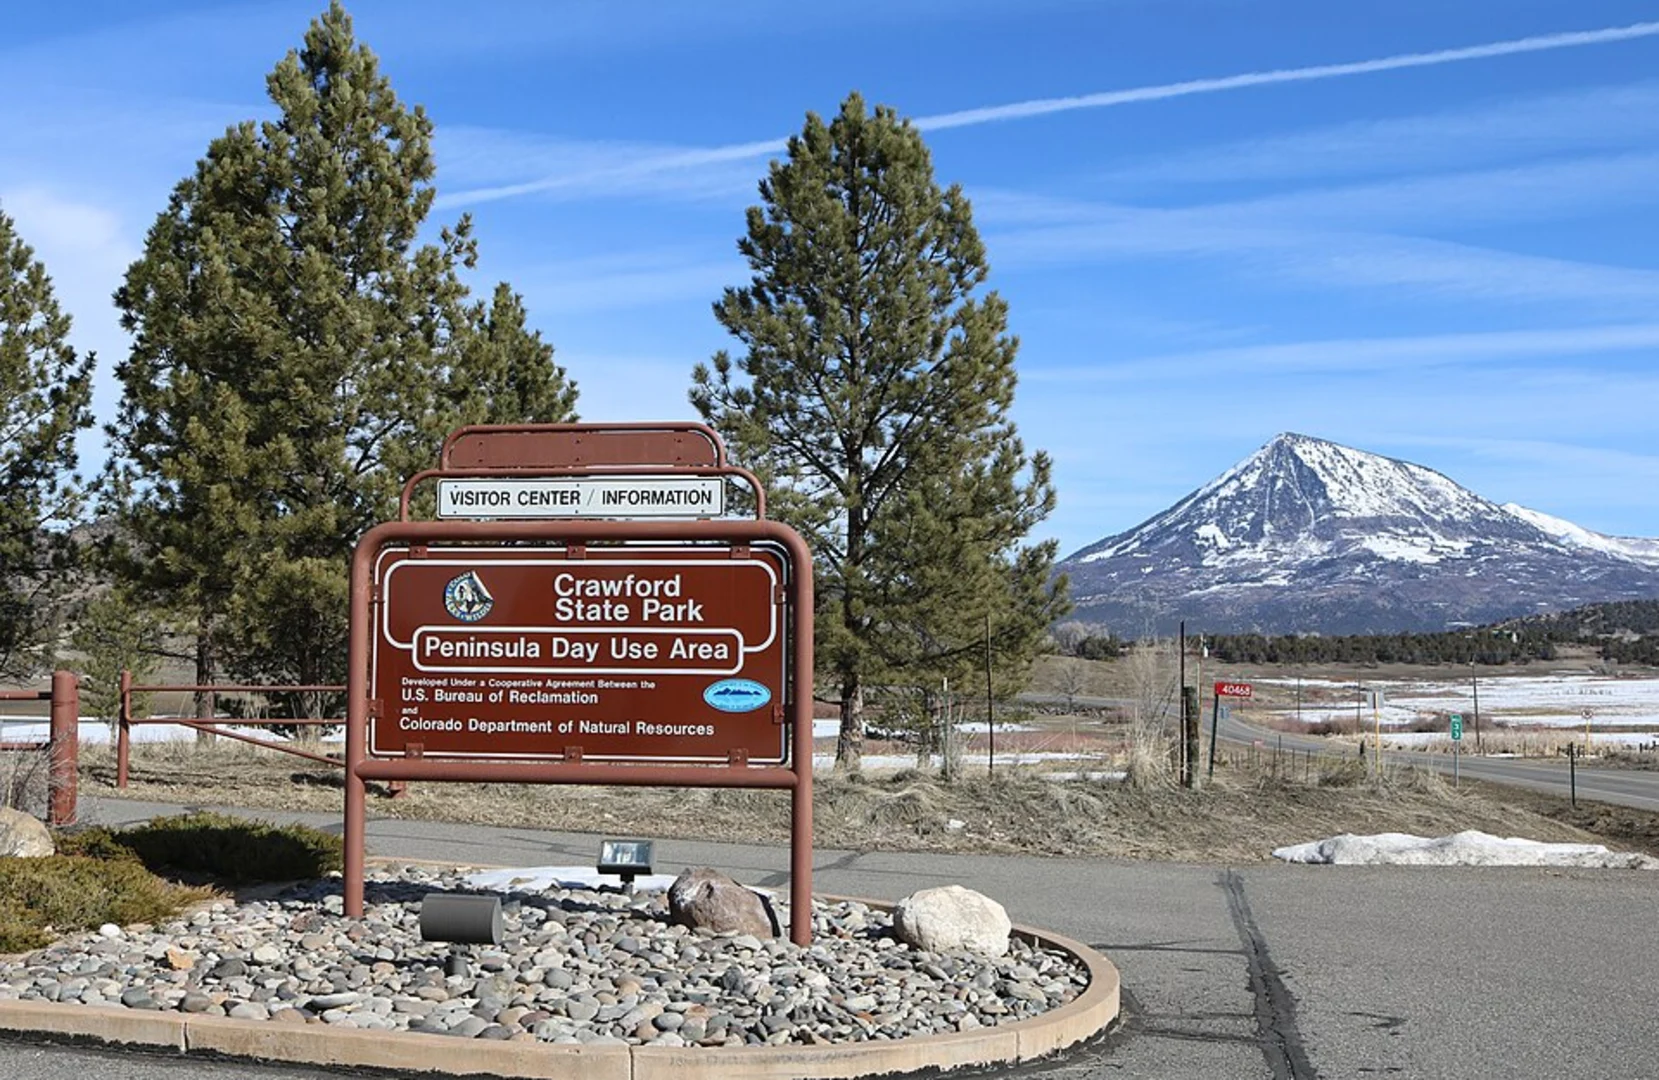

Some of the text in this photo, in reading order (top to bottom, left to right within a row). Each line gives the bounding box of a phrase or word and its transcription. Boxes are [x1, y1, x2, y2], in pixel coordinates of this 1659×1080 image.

[450, 489, 511, 506] VISITOR
[517, 489, 581, 506] CENTER
[602, 489, 713, 506] INFORMATION
[554, 573, 681, 597] Crawford
[555, 599, 704, 622] State Park
[424, 637, 729, 663] Peninsula Day Use Area
[401, 677, 448, 687] Developed
[450, 677, 476, 687] Under
[488, 678, 542, 688] Cooperative
[545, 679, 595, 689] Agreement
[597, 679, 638, 689] Between
[640, 680, 656, 689] the
[401, 687, 599, 704] U.S. Bureau of Reclamation
[401, 706, 418, 715] and
[399, 716, 715, 736] Colorado Department of Natural Resources
